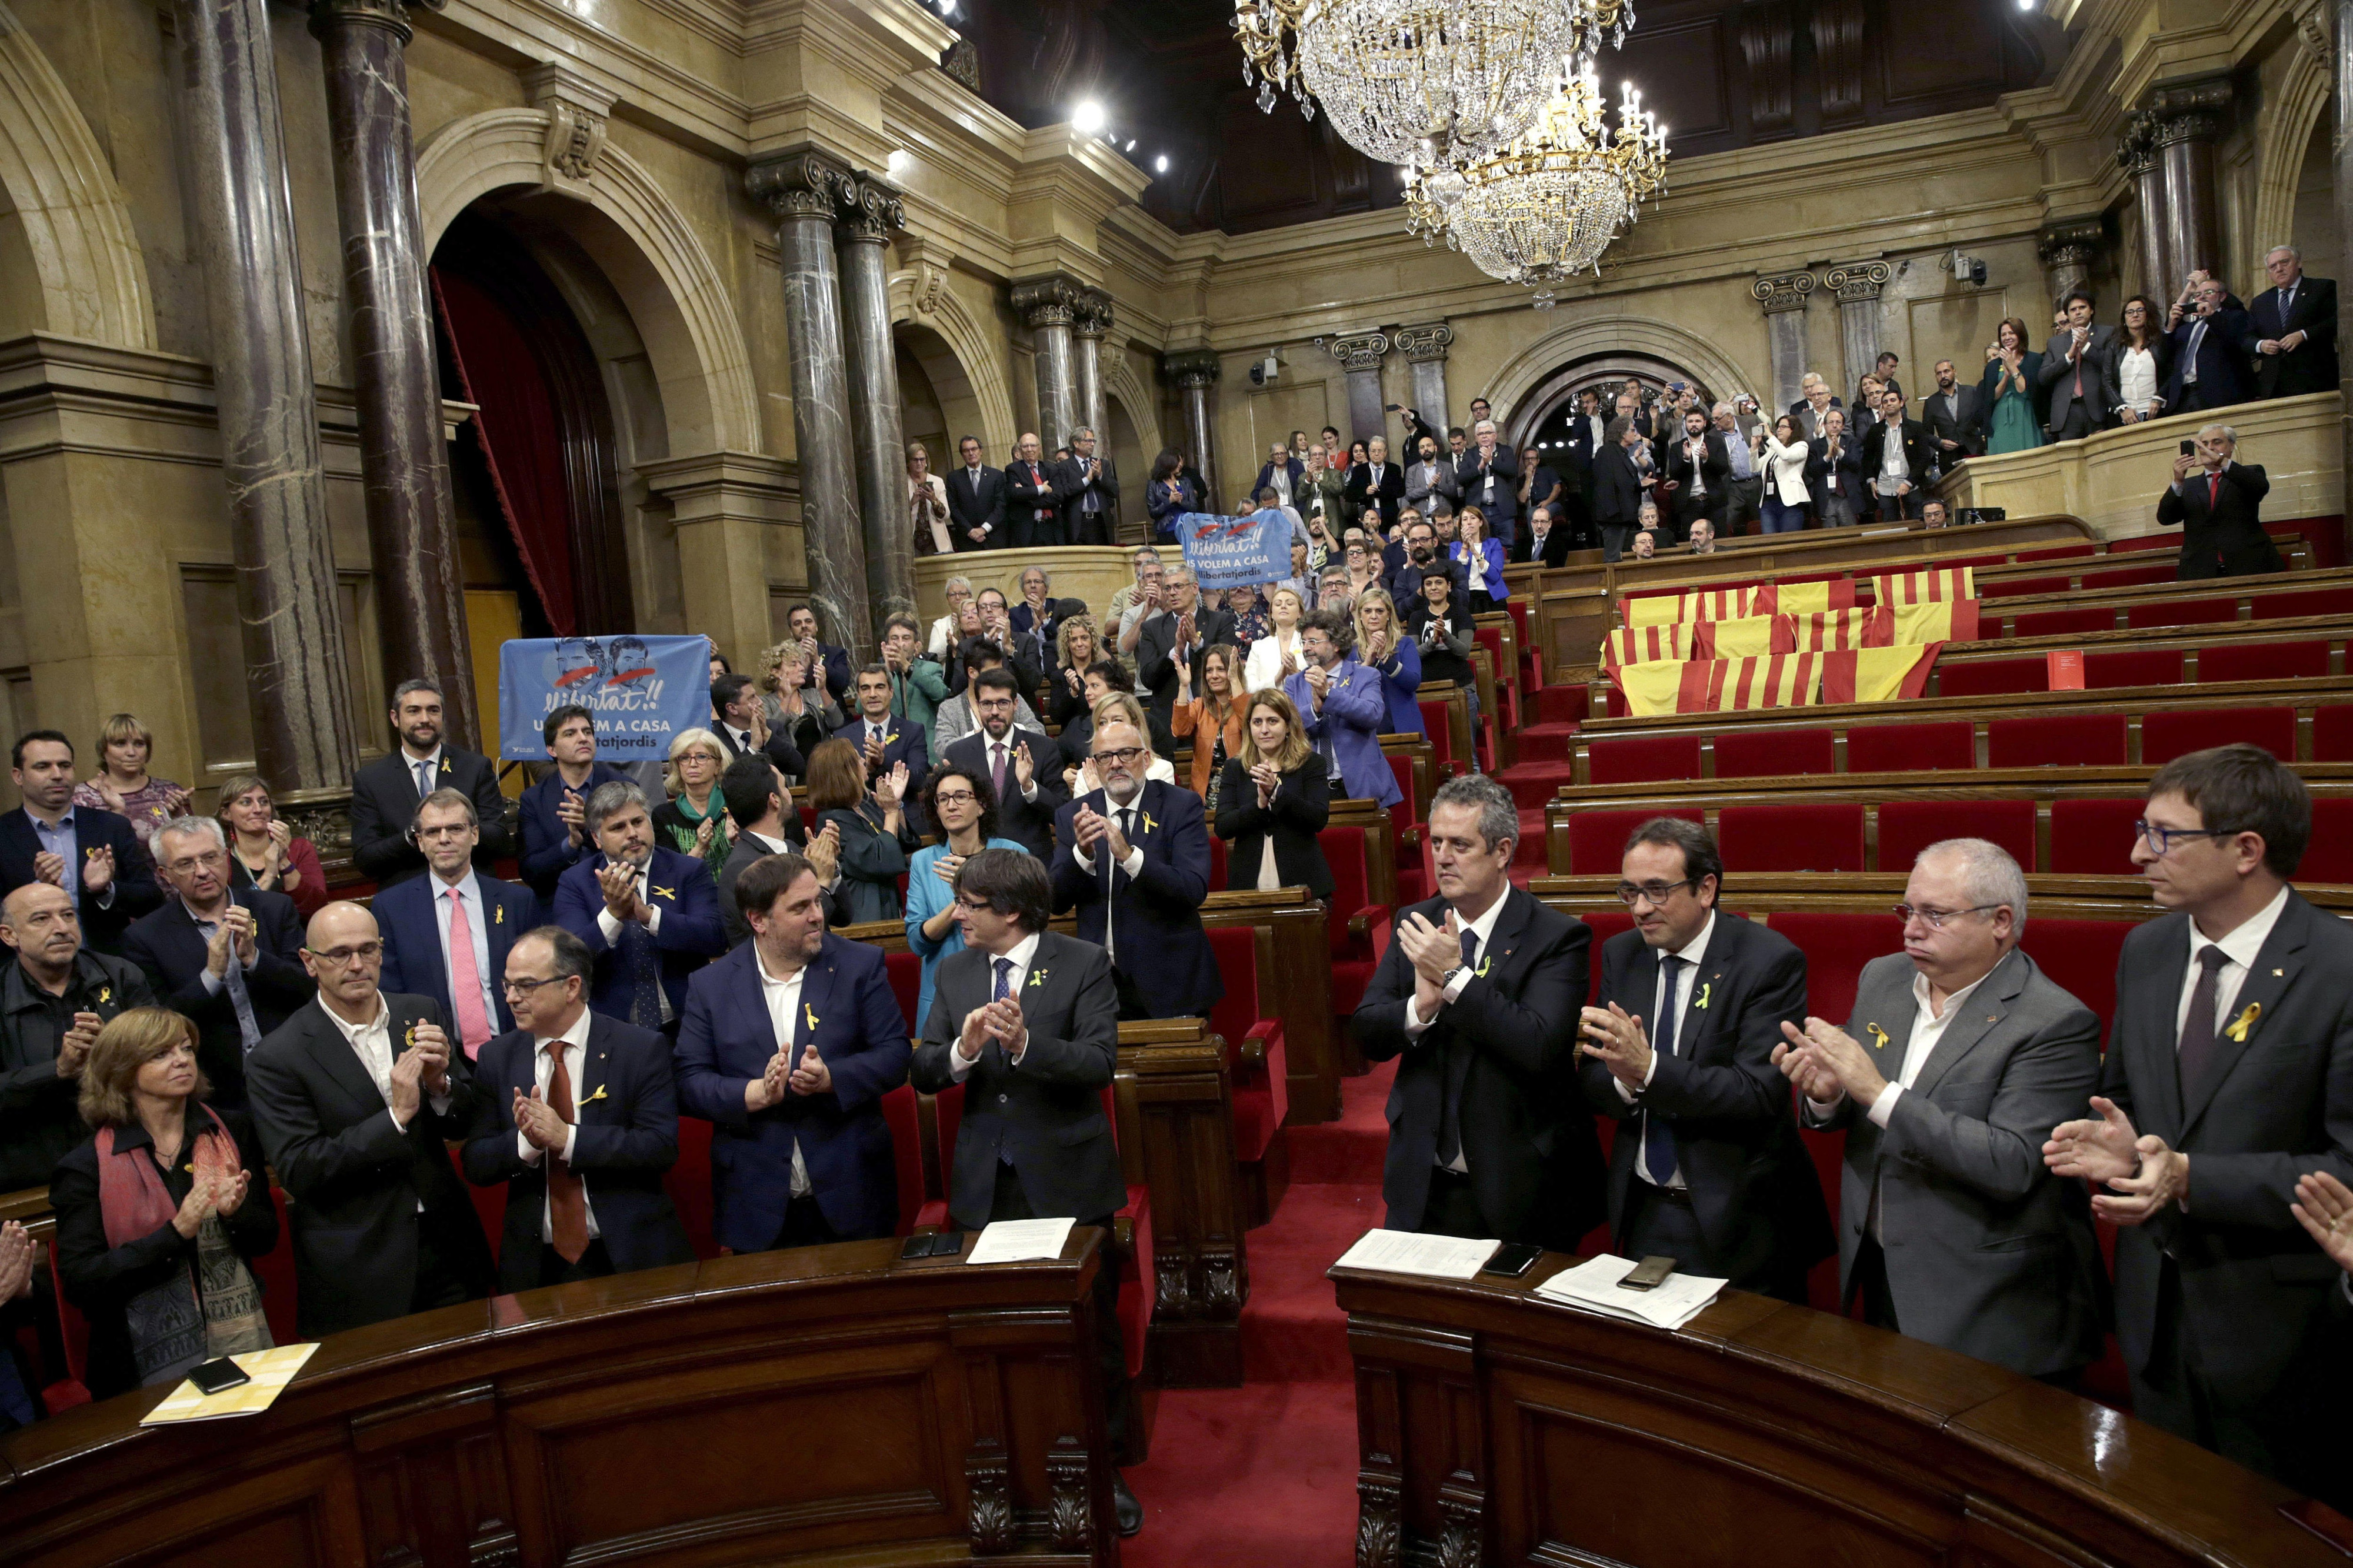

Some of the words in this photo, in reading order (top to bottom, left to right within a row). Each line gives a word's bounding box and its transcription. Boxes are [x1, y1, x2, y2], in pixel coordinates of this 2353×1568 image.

[1197, 559, 1231, 569] VOLEM
[1244, 555, 1269, 565] CASA
[1197, 567, 1261, 579] llibertatjordis
[615, 720, 626, 732] A
[631, 719, 671, 732] CASA
